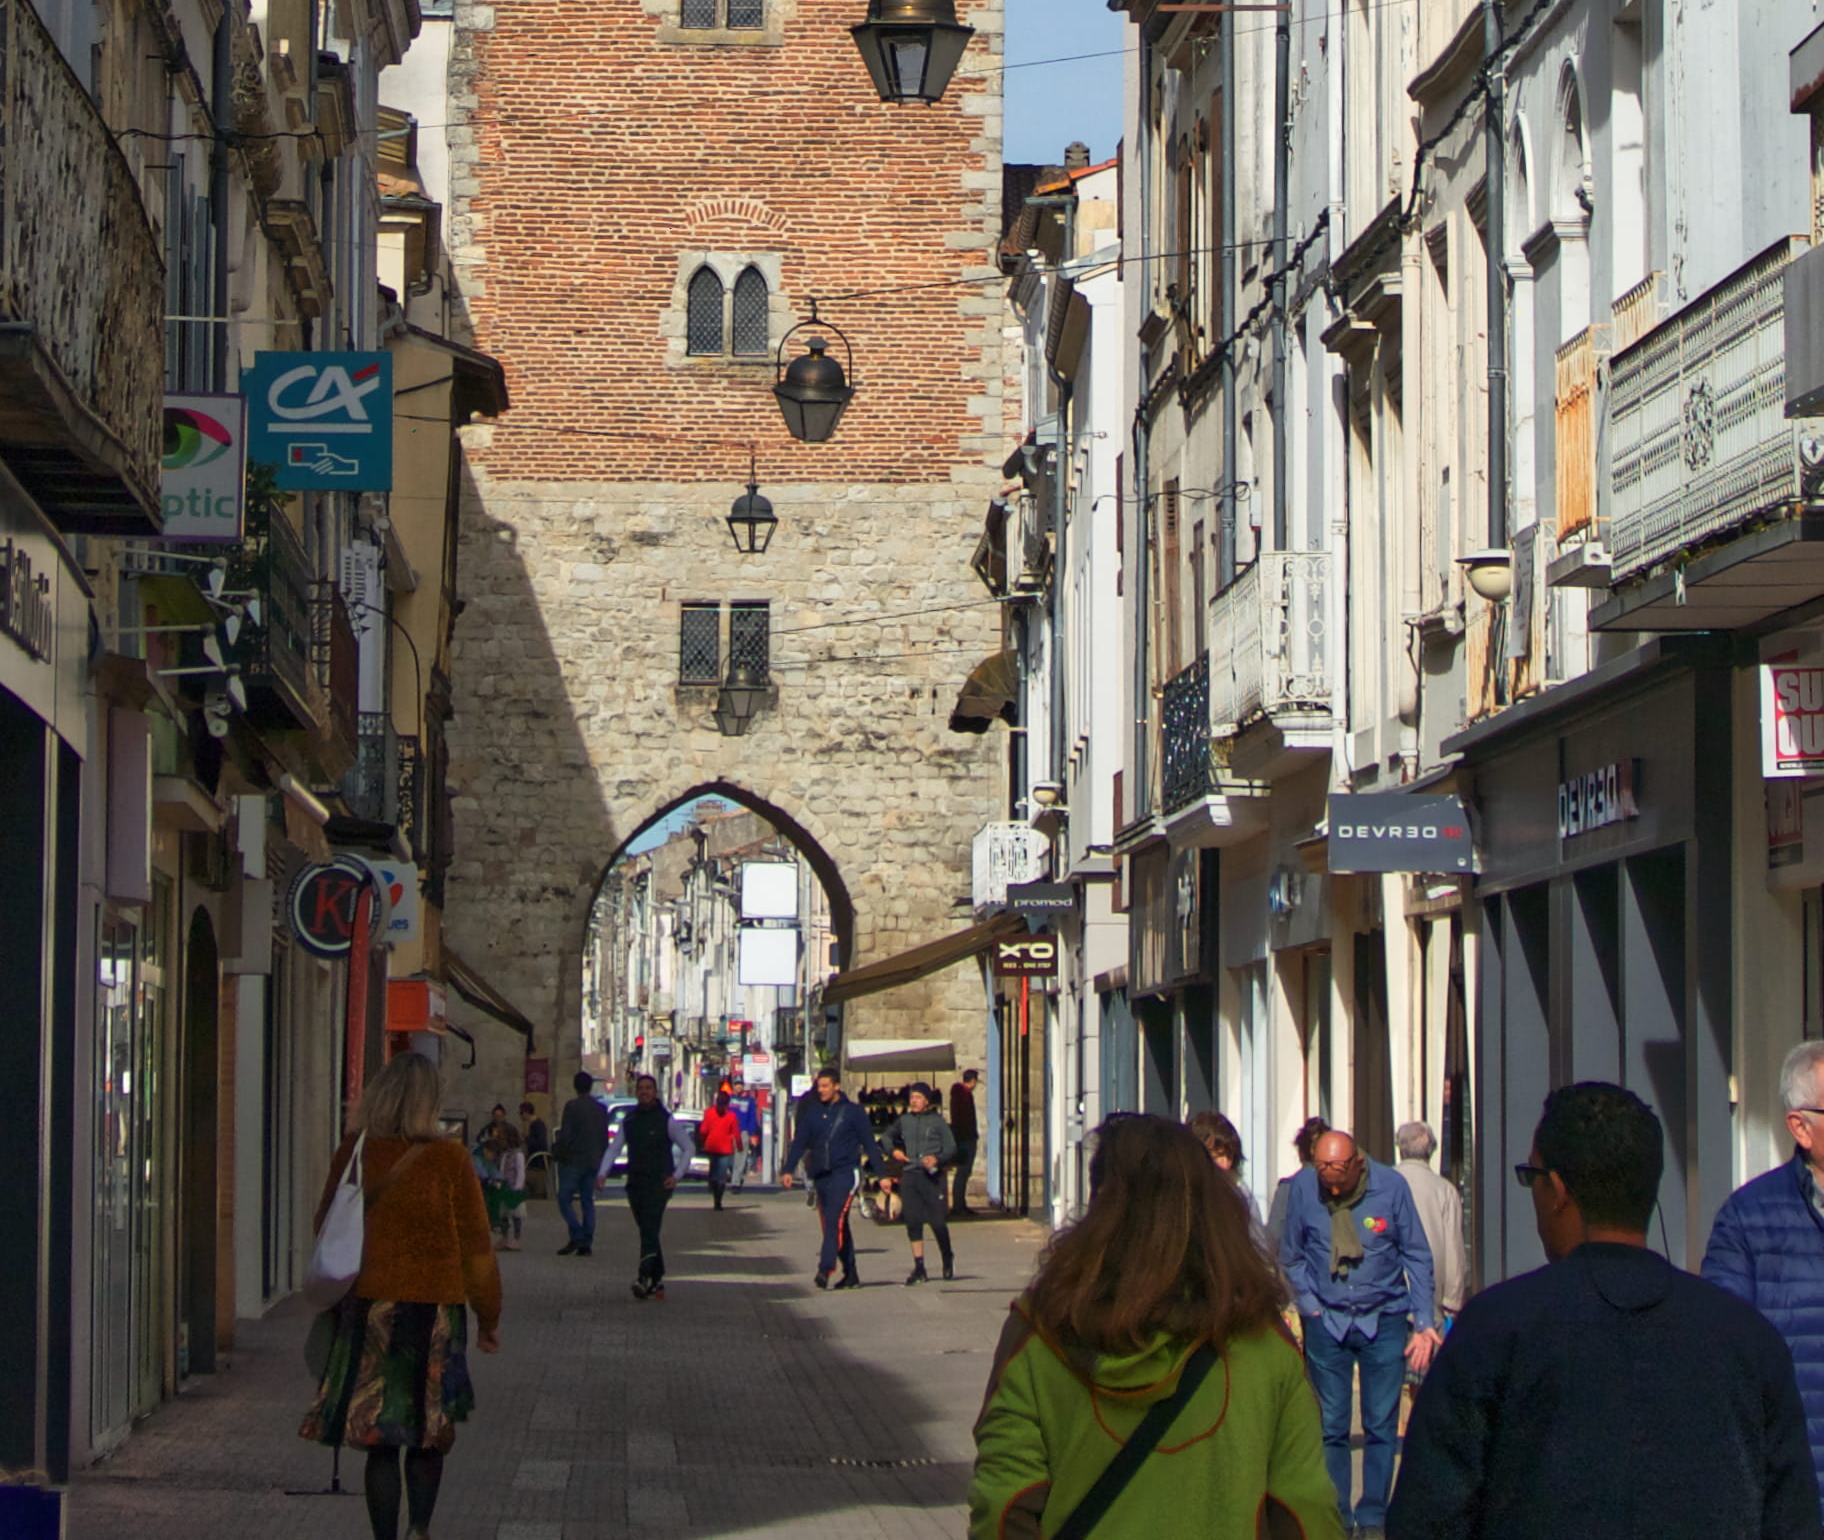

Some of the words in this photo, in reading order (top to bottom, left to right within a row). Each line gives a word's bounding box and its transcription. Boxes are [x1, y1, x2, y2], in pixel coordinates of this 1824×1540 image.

[268, 363, 380, 421] CA
[162, 488, 236, 526] ptic
[1013, 897, 1073, 909] promod
